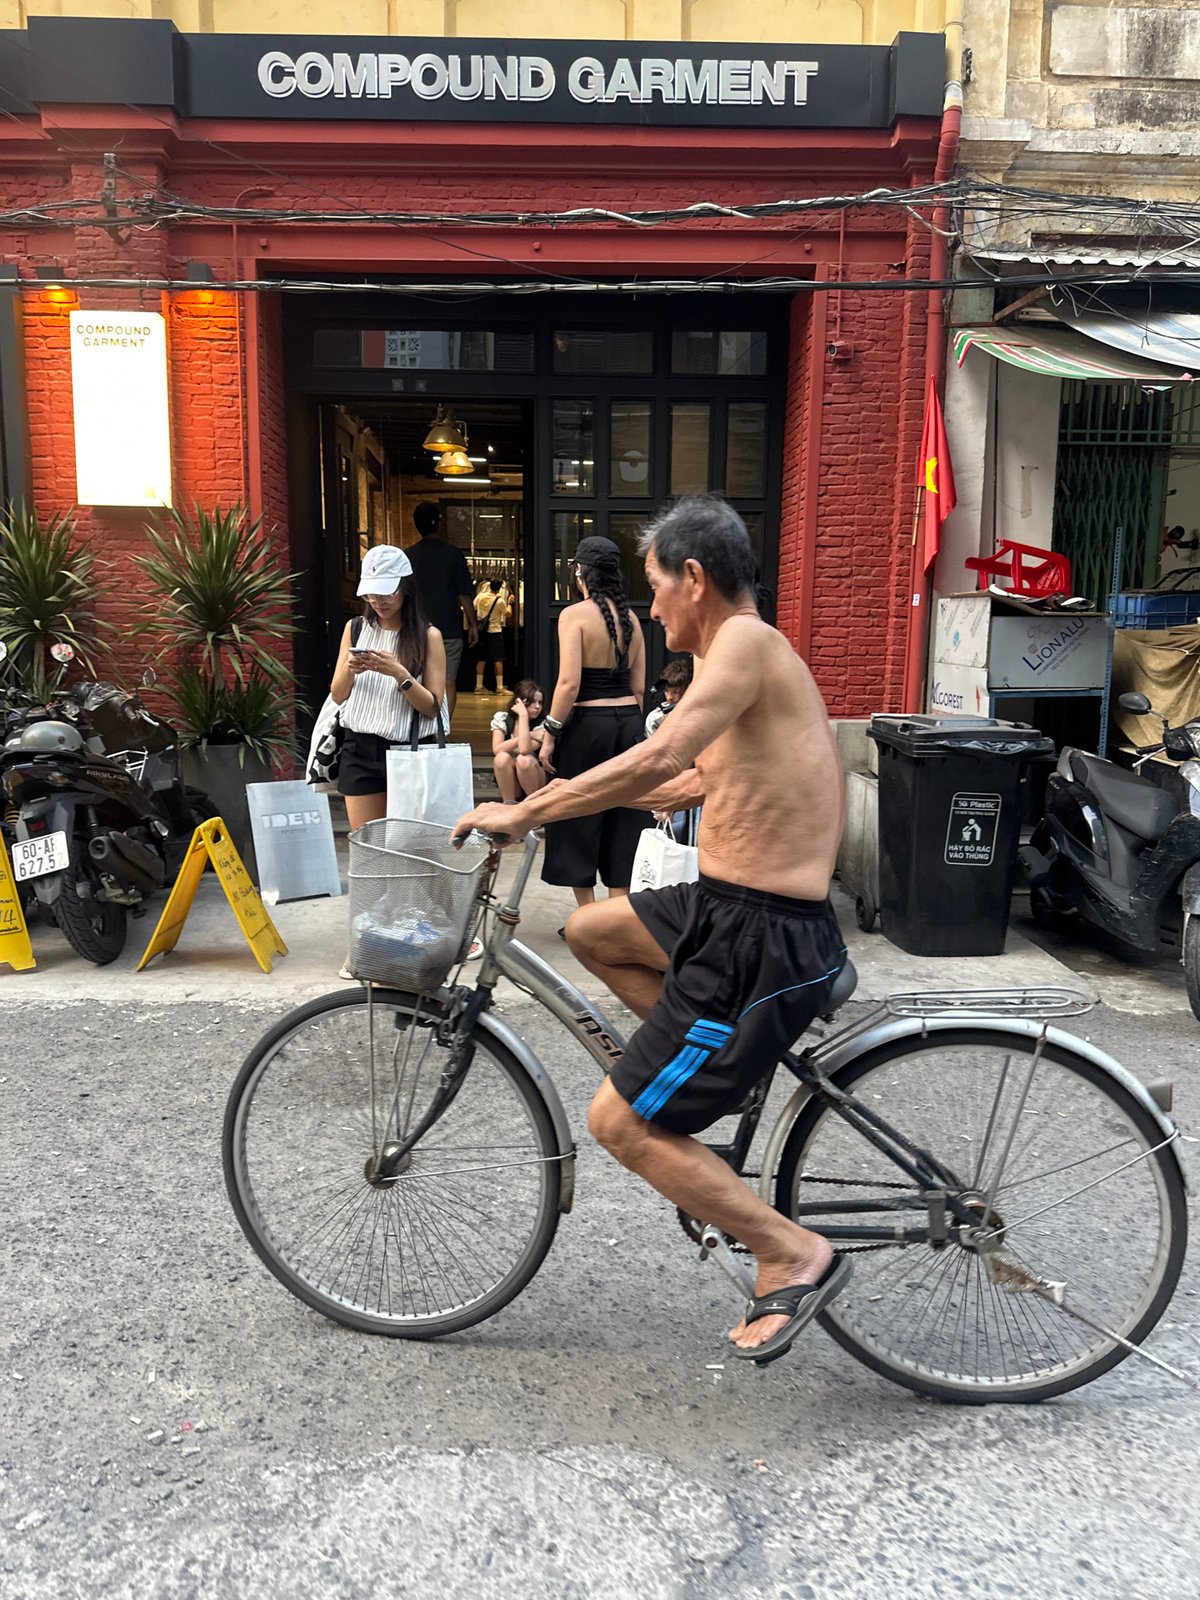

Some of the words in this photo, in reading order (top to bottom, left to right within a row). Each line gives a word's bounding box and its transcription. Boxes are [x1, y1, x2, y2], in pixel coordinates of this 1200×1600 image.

[257, 51, 556, 101] COMPOUND
[568, 56, 819, 105] GARMENT
[76, 325, 151, 336] COMPOUND
[83, 337, 145, 348] GARMENT
